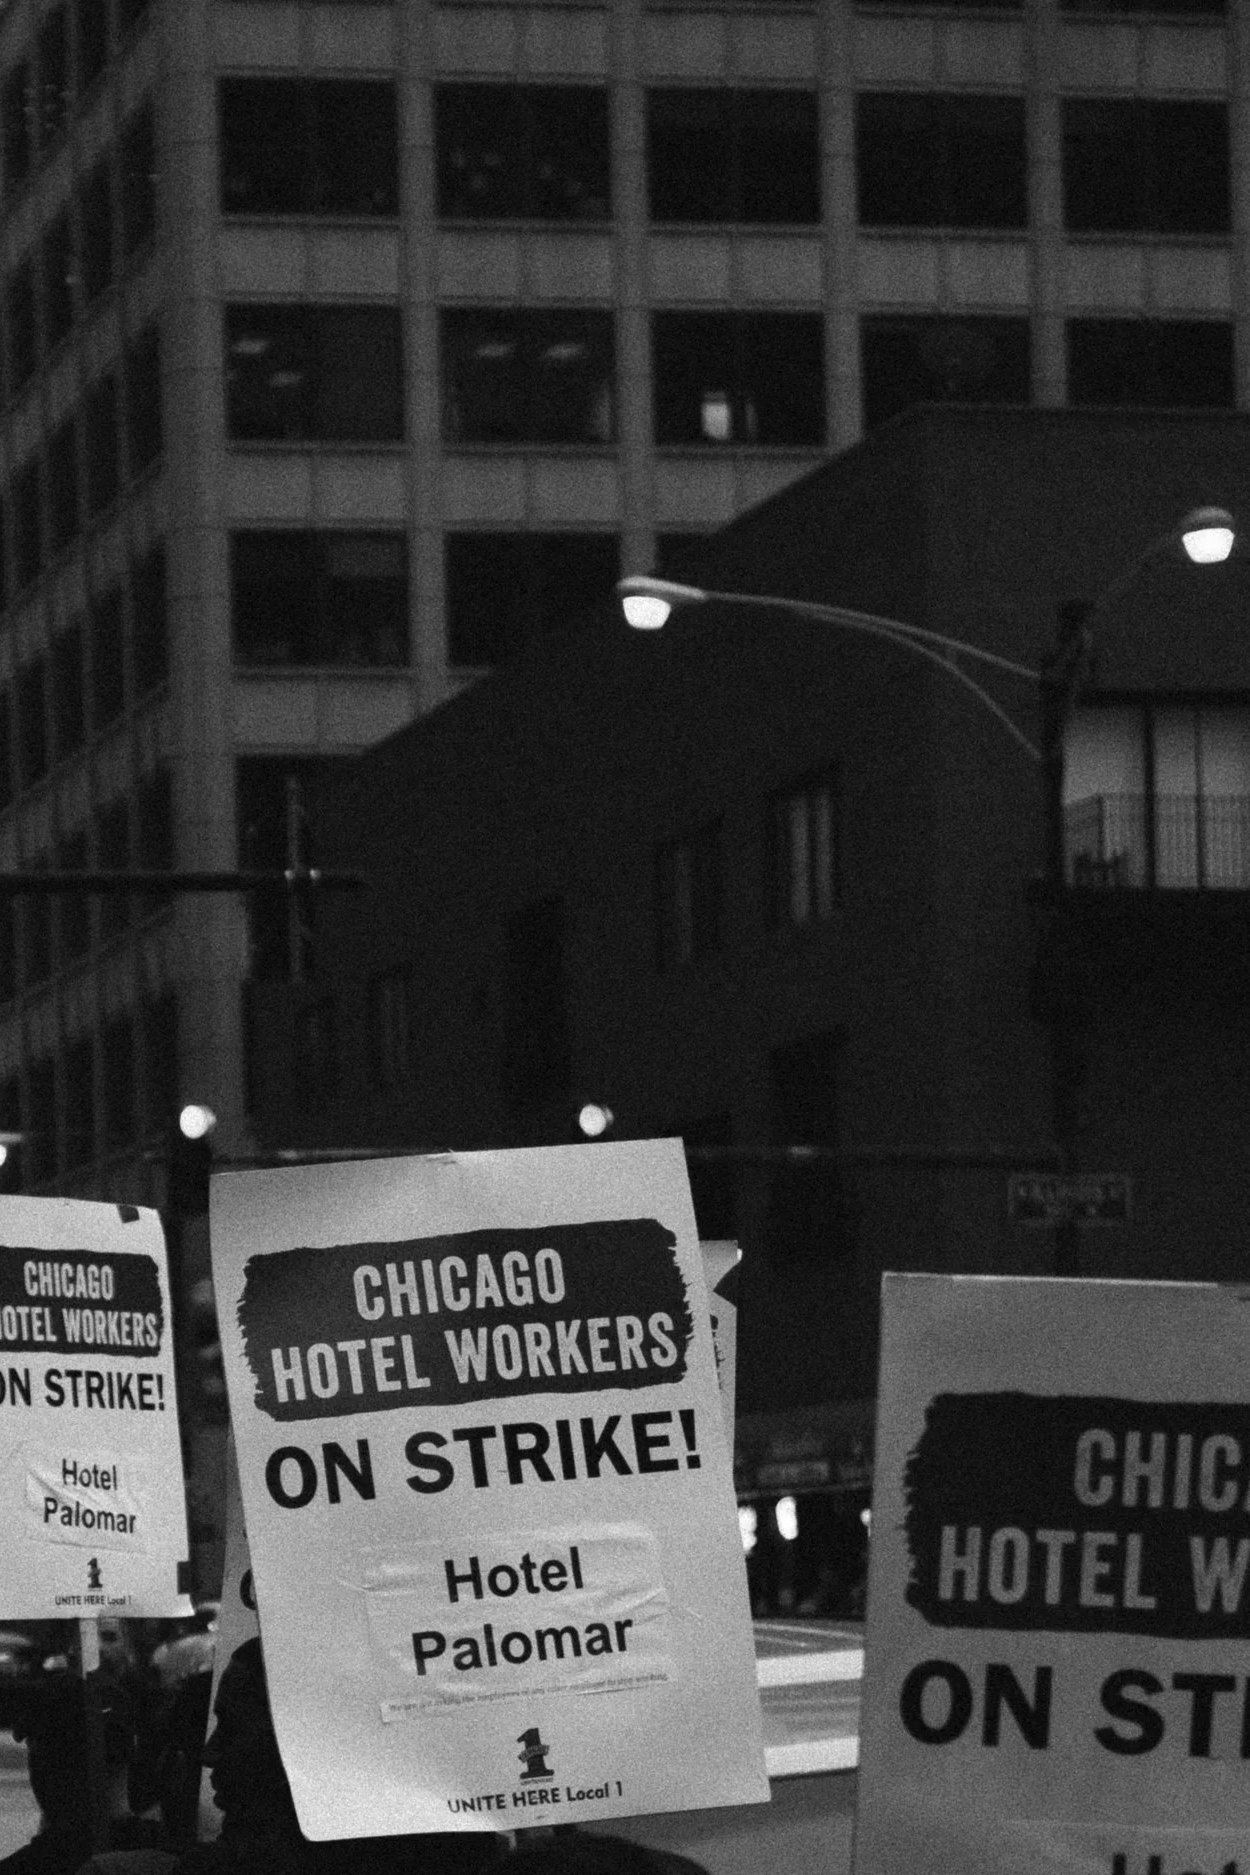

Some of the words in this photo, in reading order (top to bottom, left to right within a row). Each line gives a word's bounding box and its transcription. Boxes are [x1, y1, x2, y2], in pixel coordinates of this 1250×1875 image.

[23, 1260, 114, 1301] CHICAGO
[352, 1247, 566, 1321] CHICAGO
[62, 1307, 159, 1348] WORKERS
[271, 1333, 430, 1403] HOTEL
[444, 1311, 680, 1385] WORKERS
[45, 1368, 165, 1411] STRIKE!
[62, 1458, 117, 1491] Hotel
[264, 1437, 377, 1509] ON
[404, 1408, 702, 1495] STRIKE!
[1073, 1427, 1250, 1514] CHIC
[44, 1496, 136, 1533] Palomar
[444, 1545, 585, 1603] Hotel
[938, 1524, 1157, 1610] HOTEL
[55, 1595, 82, 1606] UNITE
[84, 1595, 105, 1606] HERE
[411, 1615, 634, 1676] Palomar
[898, 1658, 1052, 1750] ON
[447, 1793, 506, 1813] UNITE
[512, 1787, 561, 1807] HERE
[566, 1782, 610, 1801] Local
[615, 1781, 623, 1797] 1
